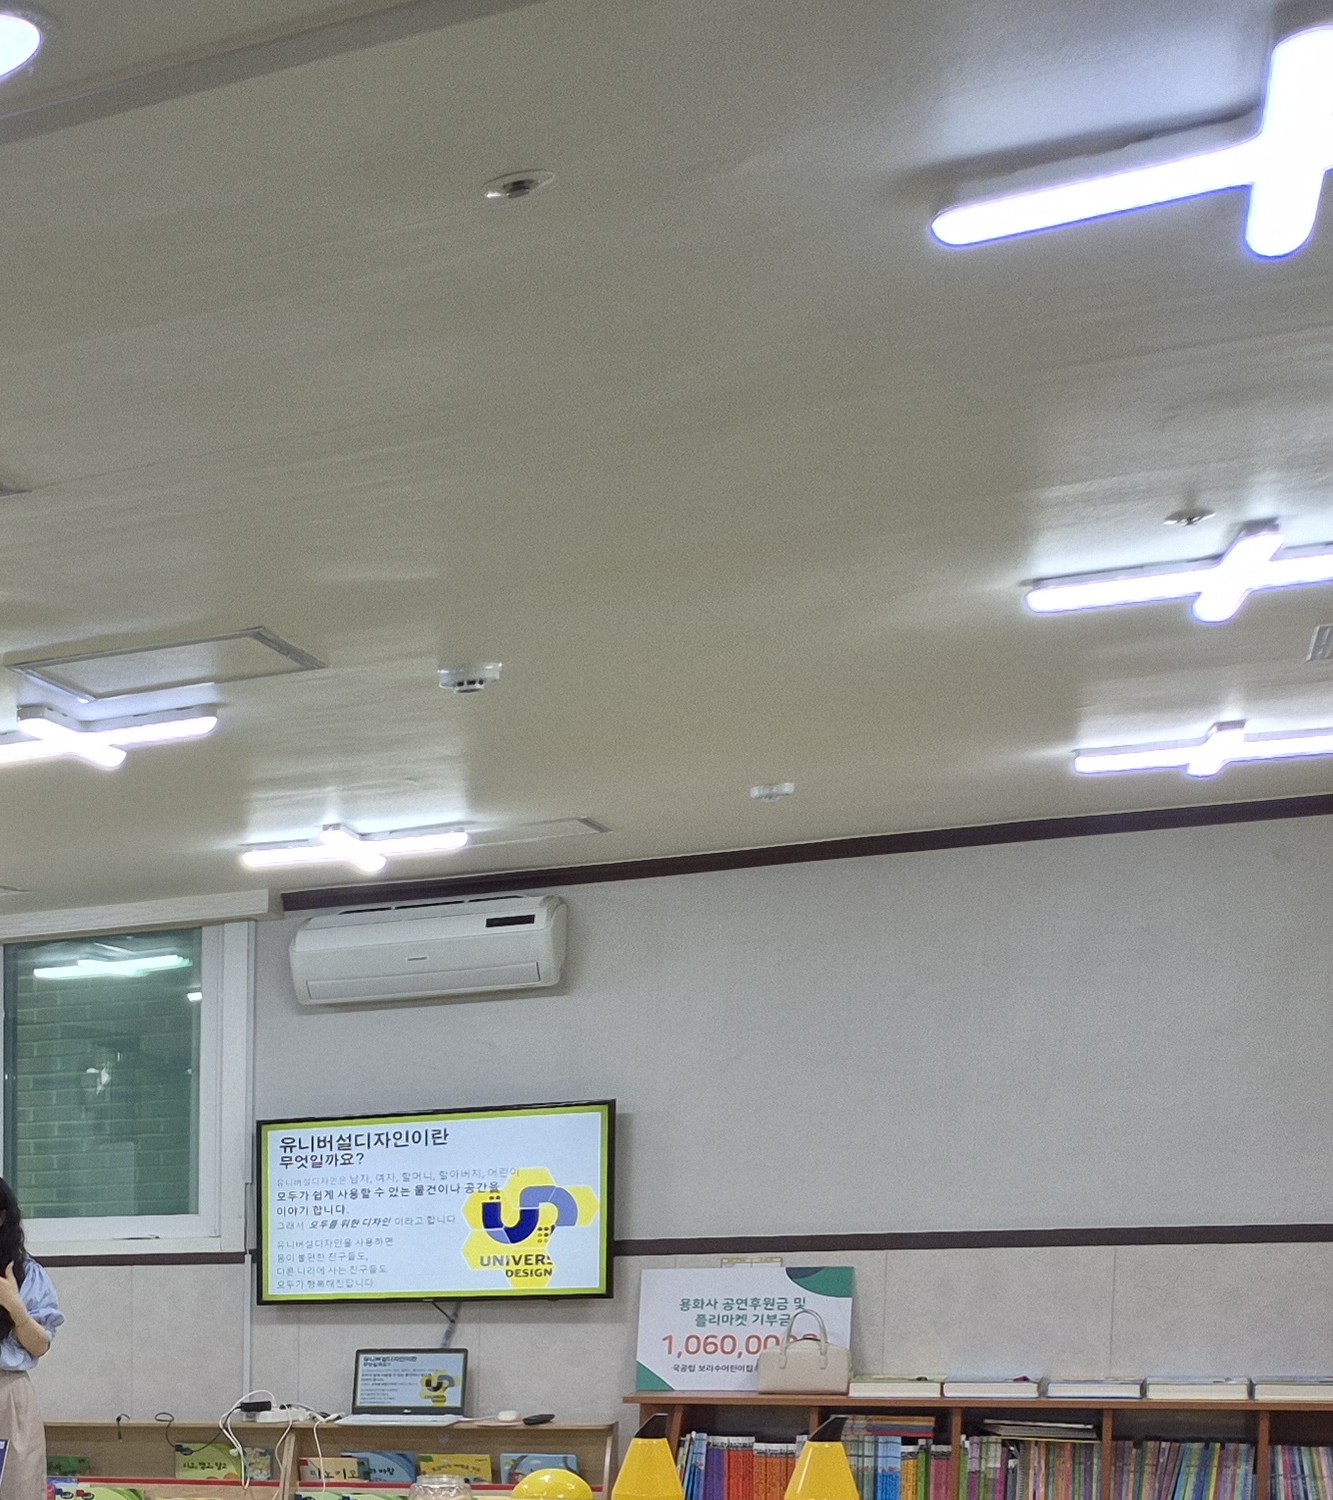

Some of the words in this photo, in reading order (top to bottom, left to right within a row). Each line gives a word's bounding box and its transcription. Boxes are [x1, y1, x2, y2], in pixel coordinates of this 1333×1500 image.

[279, 1128, 449, 1153] 유니버설디자인이란
[279, 1153, 364, 1169] 무엇일까요?
[277, 1190, 309, 1202] 모두가
[313, 1189, 334, 1201] 쉽게
[337, 1187, 371, 1200] 사용할
[374, 1186, 385, 1198] 수
[388, 1186, 411, 1198] 있는
[414, 1183, 461, 1196] 물건이나
[465, 1180, 501, 1194] 공간을
[276, 1205, 309, 1217] 이야기
[362, 1216, 392, 1227] 디자인
[505, 1268, 553, 1278] DESIGN
[679, 1298, 718, 1311] 용화사
[722, 1297, 789, 1311] 공연후원금
[695, 1313, 747, 1327] 플리마켓
